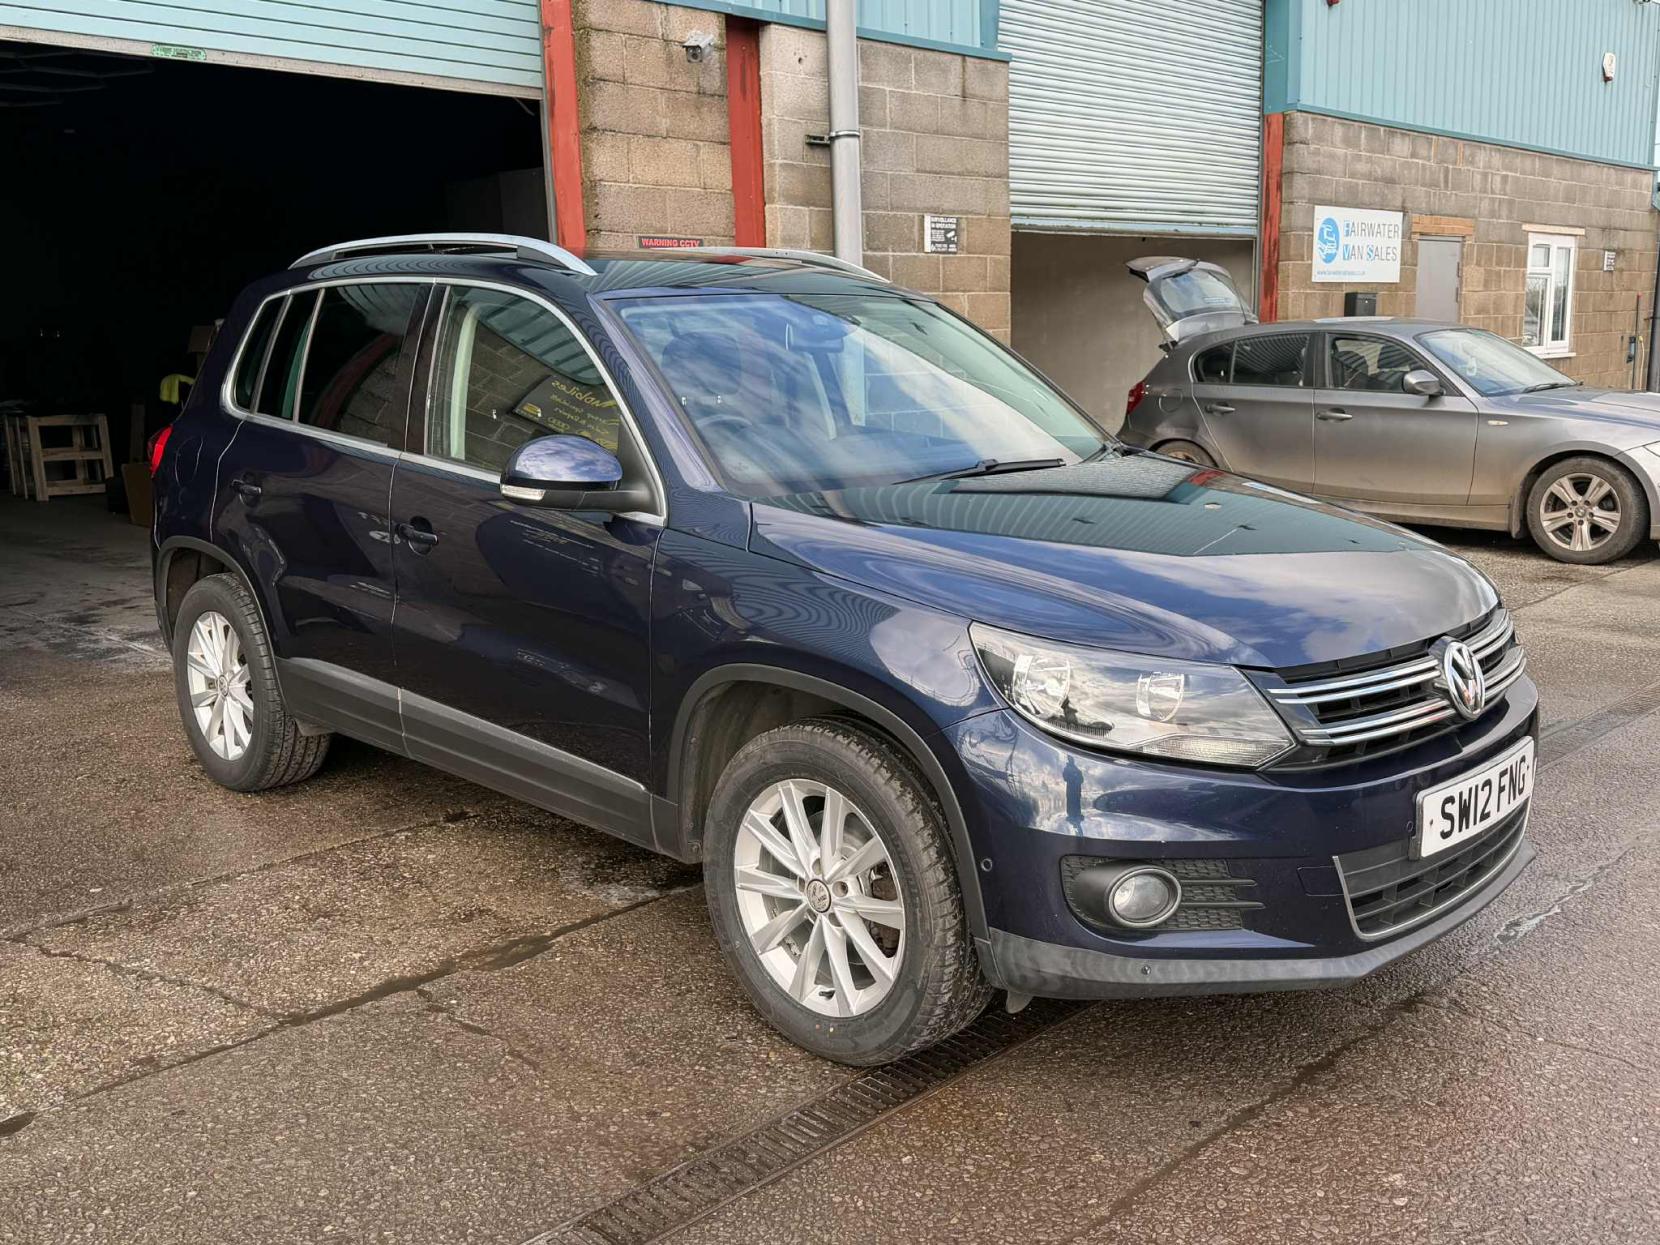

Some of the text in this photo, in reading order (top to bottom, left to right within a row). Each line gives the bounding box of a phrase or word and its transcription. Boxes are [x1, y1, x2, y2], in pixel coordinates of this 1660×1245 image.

[1343, 220, 1400, 239] FAIRWATER
[642, 238, 701, 247] WARNING CCTV
[1343, 244, 1398, 262] VAN SALES
[1440, 754, 1526, 840] SW12 FNG
